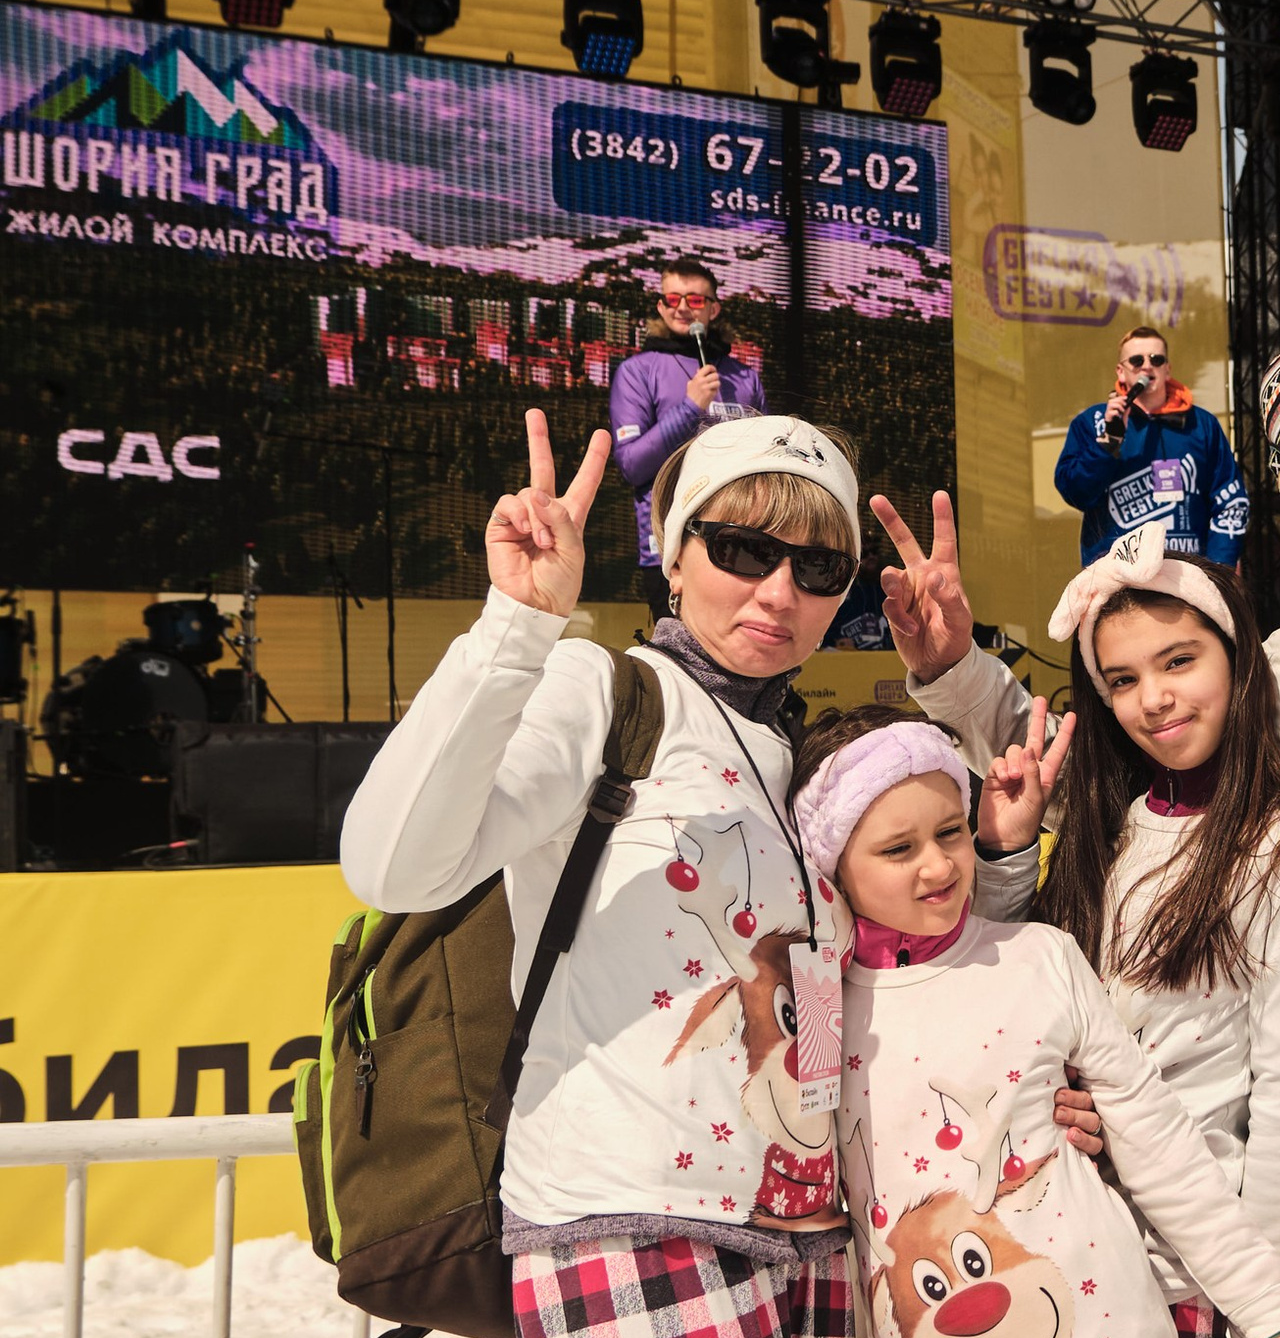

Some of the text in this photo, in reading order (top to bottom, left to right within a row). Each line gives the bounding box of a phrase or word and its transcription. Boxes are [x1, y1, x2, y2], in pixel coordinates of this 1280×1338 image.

[4, 130, 182, 203] ШОРИЯ
[570, 127, 680, 171] (3842)
[5, 208, 328, 262] ЖИЛОЙ КОМПЛЕКС
[1005, 274, 1066, 311] FEST
[57, 428, 222, 483] СДС
[1113, 475, 1155, 506] GRELK
[1120, 496, 1154, 523] FEST
[0, 1016, 322, 1124] ила
